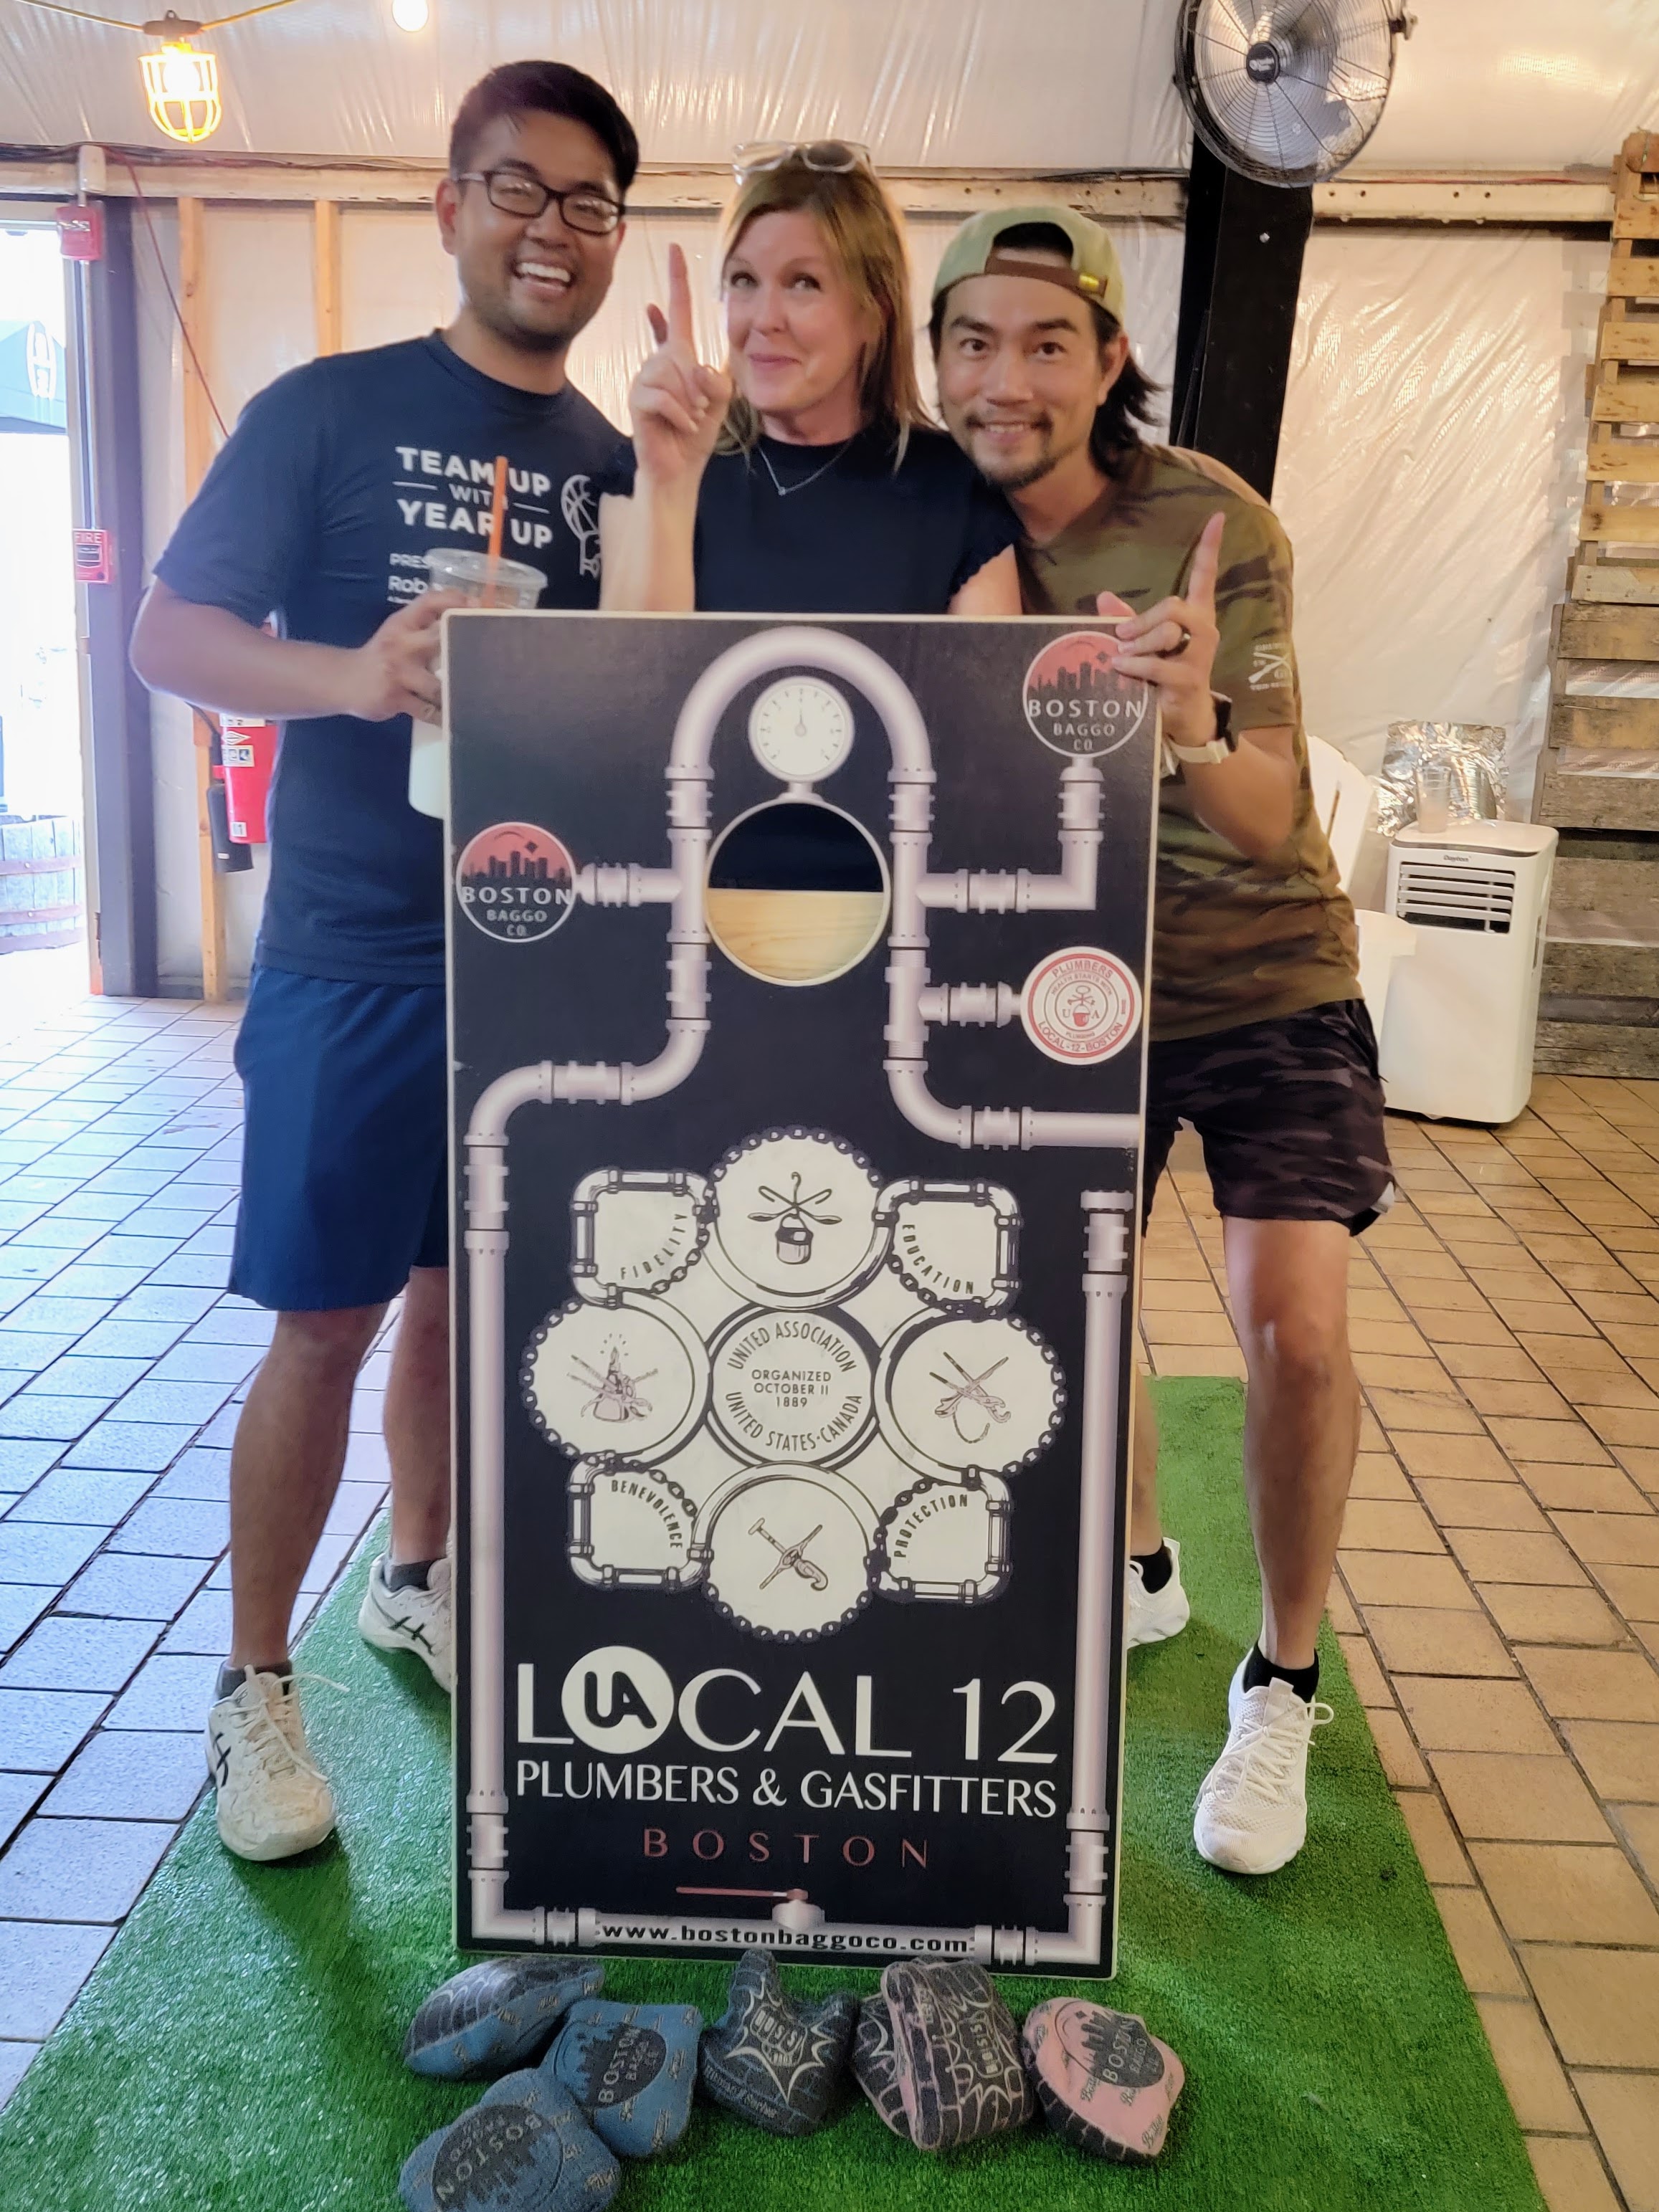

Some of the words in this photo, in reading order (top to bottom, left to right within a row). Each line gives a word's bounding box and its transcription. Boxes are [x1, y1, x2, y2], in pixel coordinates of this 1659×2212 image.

[395, 446, 495, 487] TEAM
[508, 467, 551, 497] UP
[396, 498, 495, 537] YEAR
[510, 518, 553, 549] UP
[75, 533, 103, 543] FIRE
[389, 553, 430, 569] PRES
[388, 575, 429, 594] Rob
[1028, 699, 1141, 718] BOSTON
[1053, 723, 1116, 737] BAGGO
[462, 886, 571, 905] BOSTON
[486, 909, 548, 923] BAGGO
[1051, 960, 1113, 978] PLUMBERS
[620, 1214, 688, 1279] FIDELITY
[902, 1224, 974, 1294] EDUCATION
[727, 1327, 771, 1370] UNITED
[775, 1320, 857, 1372] ASSOCIATION
[751, 1368, 832, 1382] ORGANIZED
[754, 1382, 814, 1395] OCTOBER
[726, 1392, 764, 1439] UNITED
[776, 1396, 808, 1408] 1889
[612, 1479, 683, 1548] BENEVOLENCE
[893, 1494, 968, 1558] PROTECTION
[953, 1678, 1058, 1763] 12
[518, 1760, 739, 1805] PLUMBERS
[753, 1768, 787, 1807] &
[800, 1770, 1056, 1818] GASFITTERS
[644, 1828, 928, 1868] BOSTON
[602, 1925, 967, 1953] www.bostonbaggoco.com
